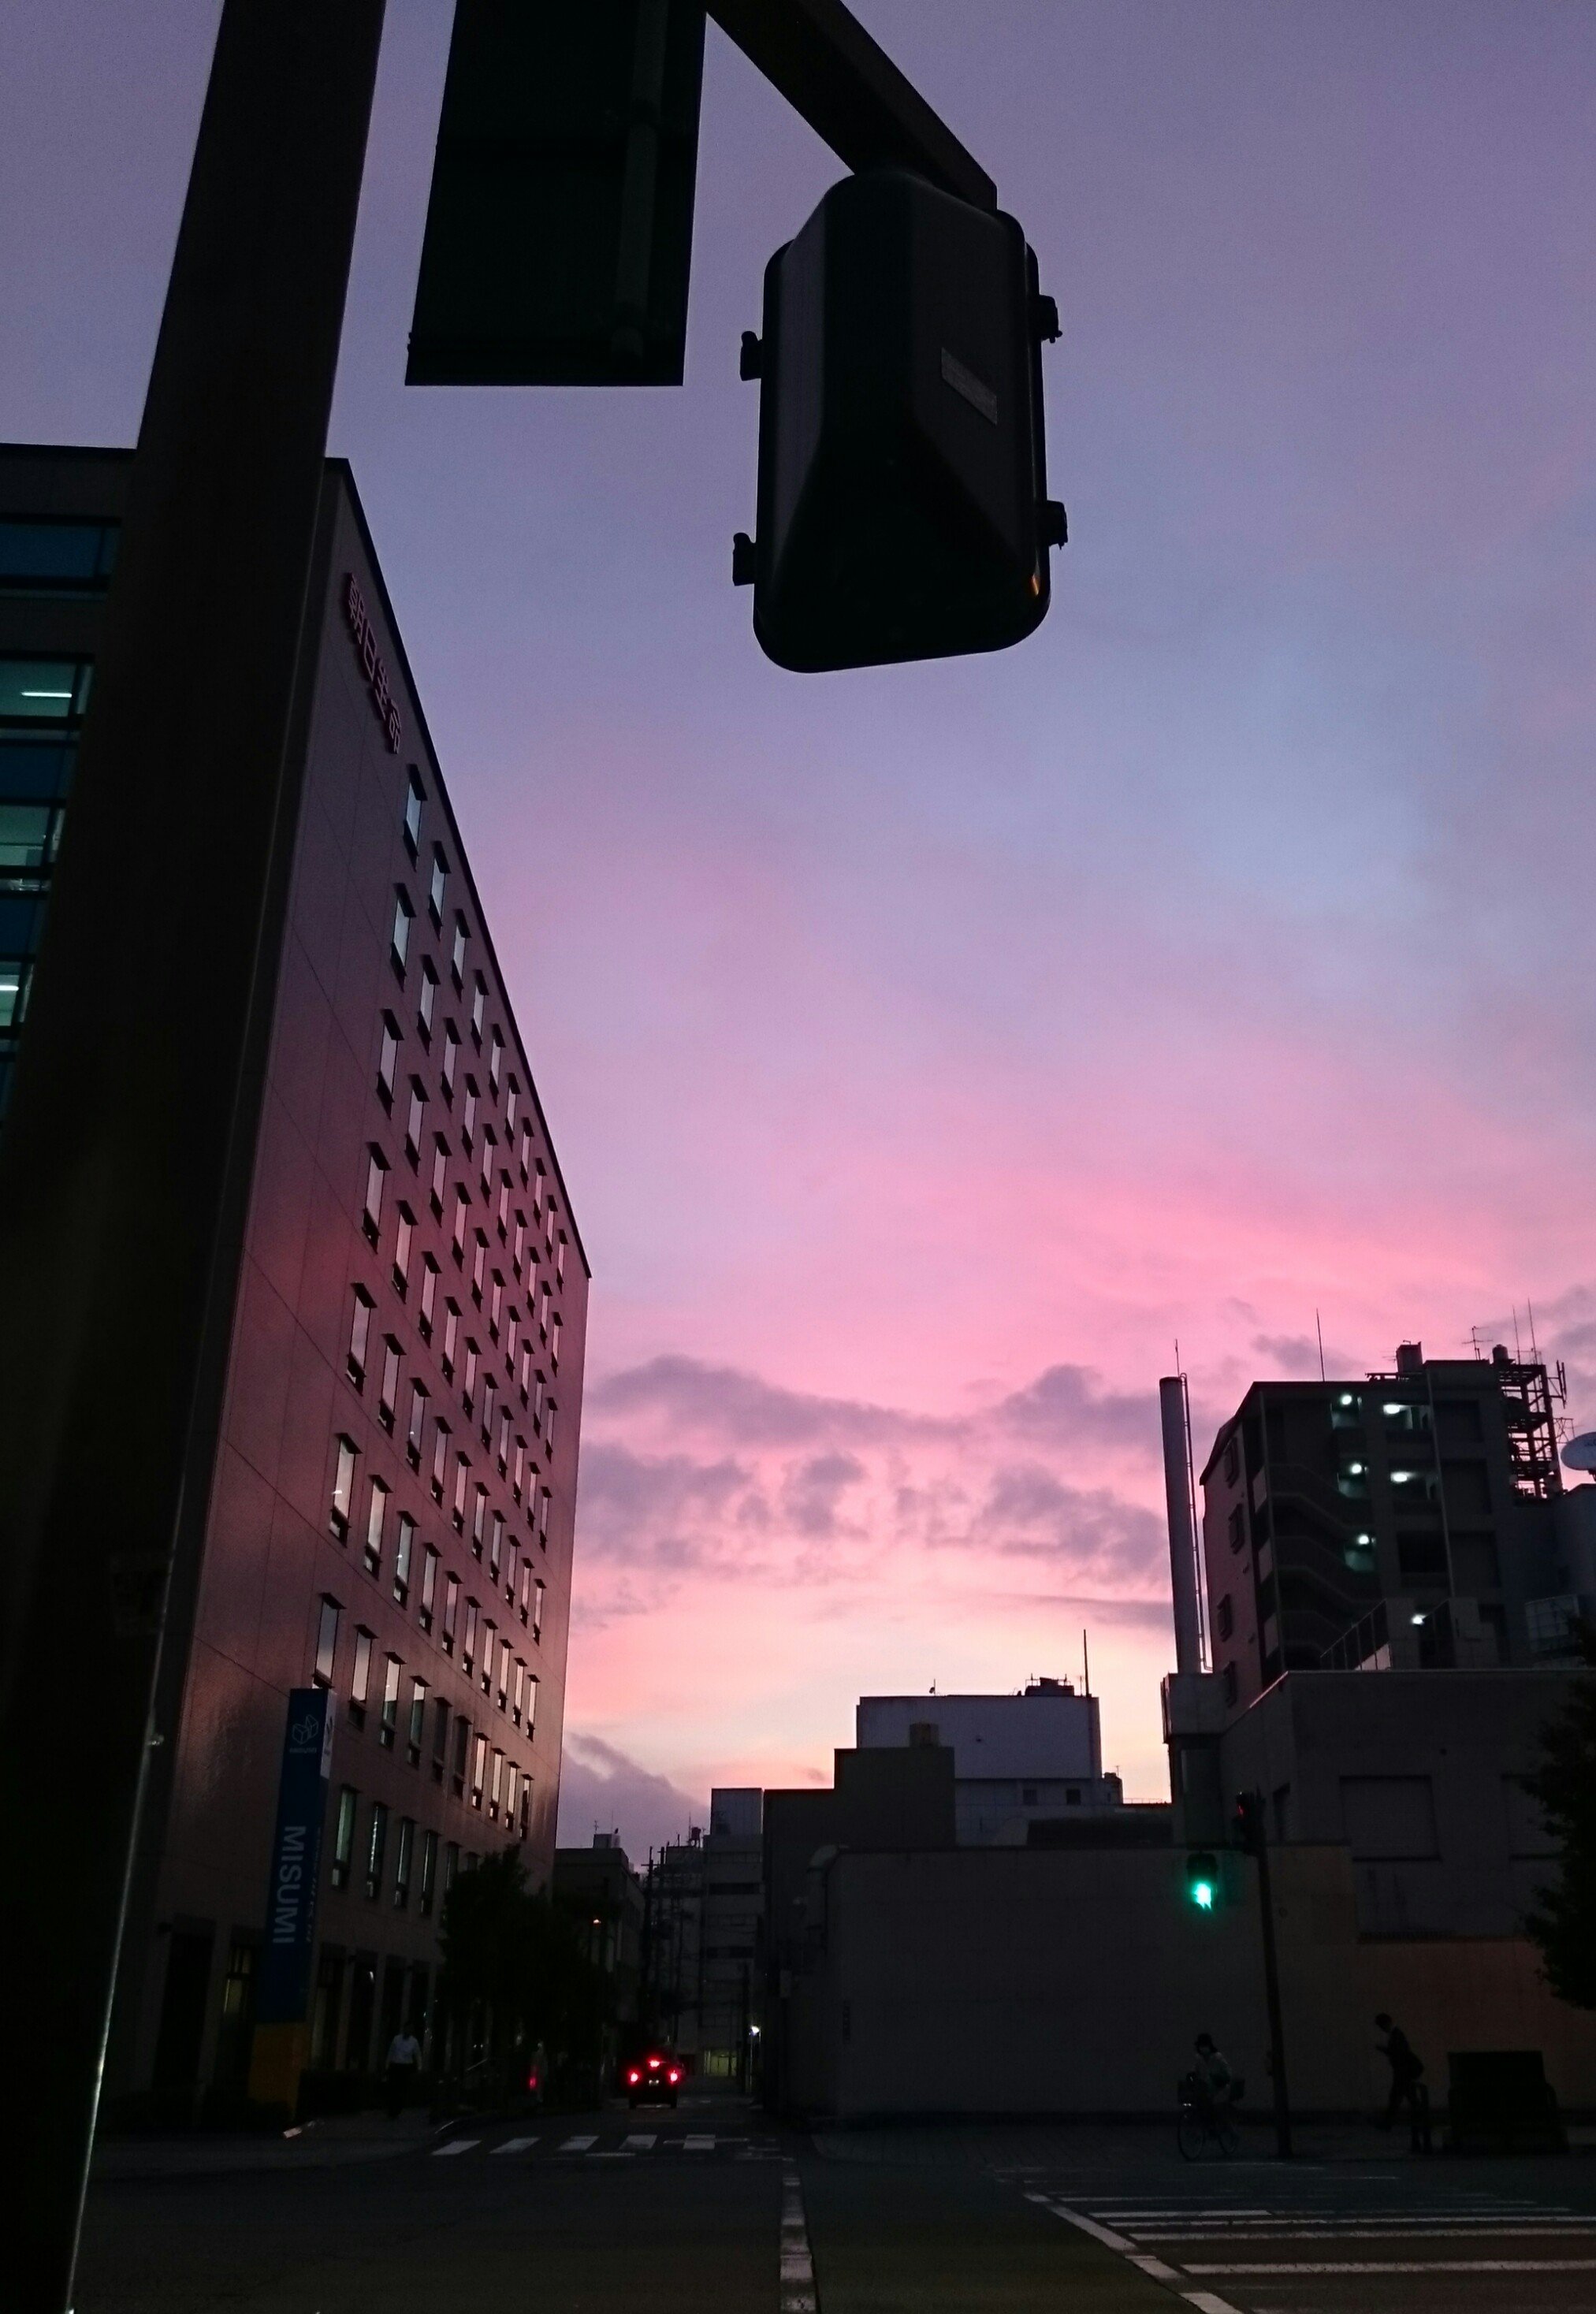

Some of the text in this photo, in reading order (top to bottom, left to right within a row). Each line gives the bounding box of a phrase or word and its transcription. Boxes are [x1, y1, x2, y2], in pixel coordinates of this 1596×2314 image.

[344, 573, 401, 753] 朝日生命
[272, 1825, 307, 1944] MISUMI
